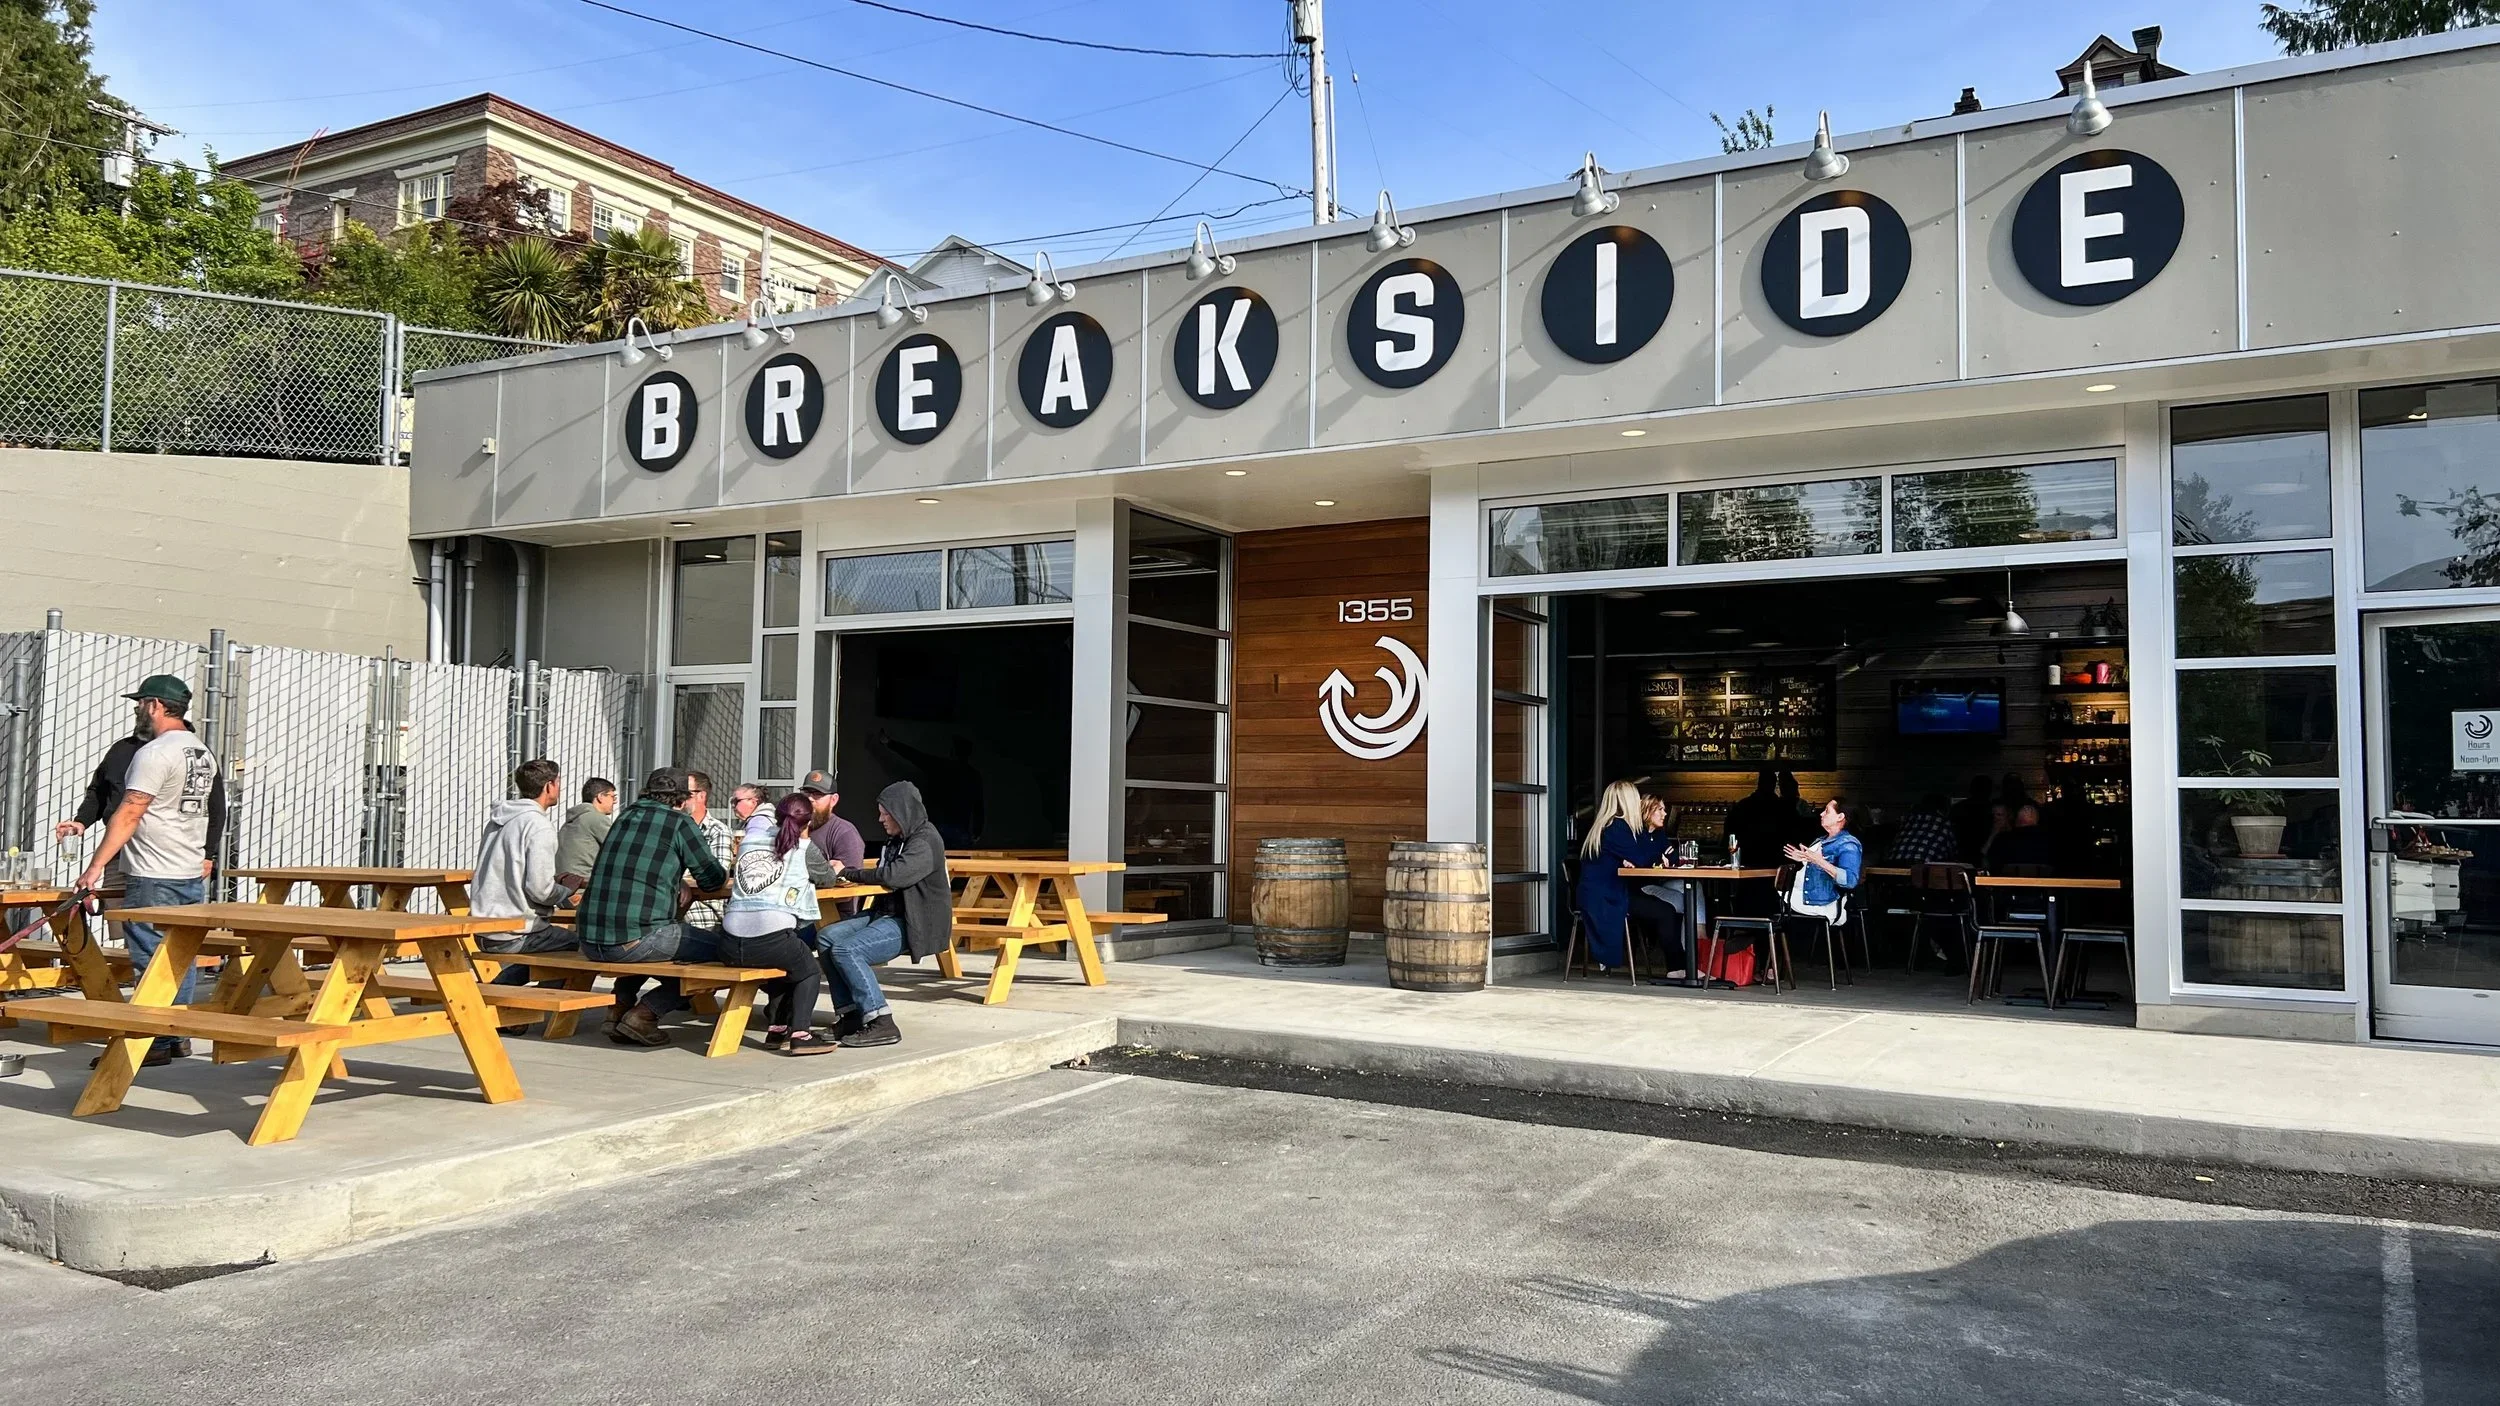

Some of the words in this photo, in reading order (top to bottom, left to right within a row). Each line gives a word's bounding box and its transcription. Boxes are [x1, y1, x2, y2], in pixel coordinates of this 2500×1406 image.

[641, 164, 2135, 461] BREAKSIDE
[1338, 598, 1413, 623] 1355
[2467, 740, 2491, 749] Hours
[2460, 754, 2499, 765] Noon-11pm
